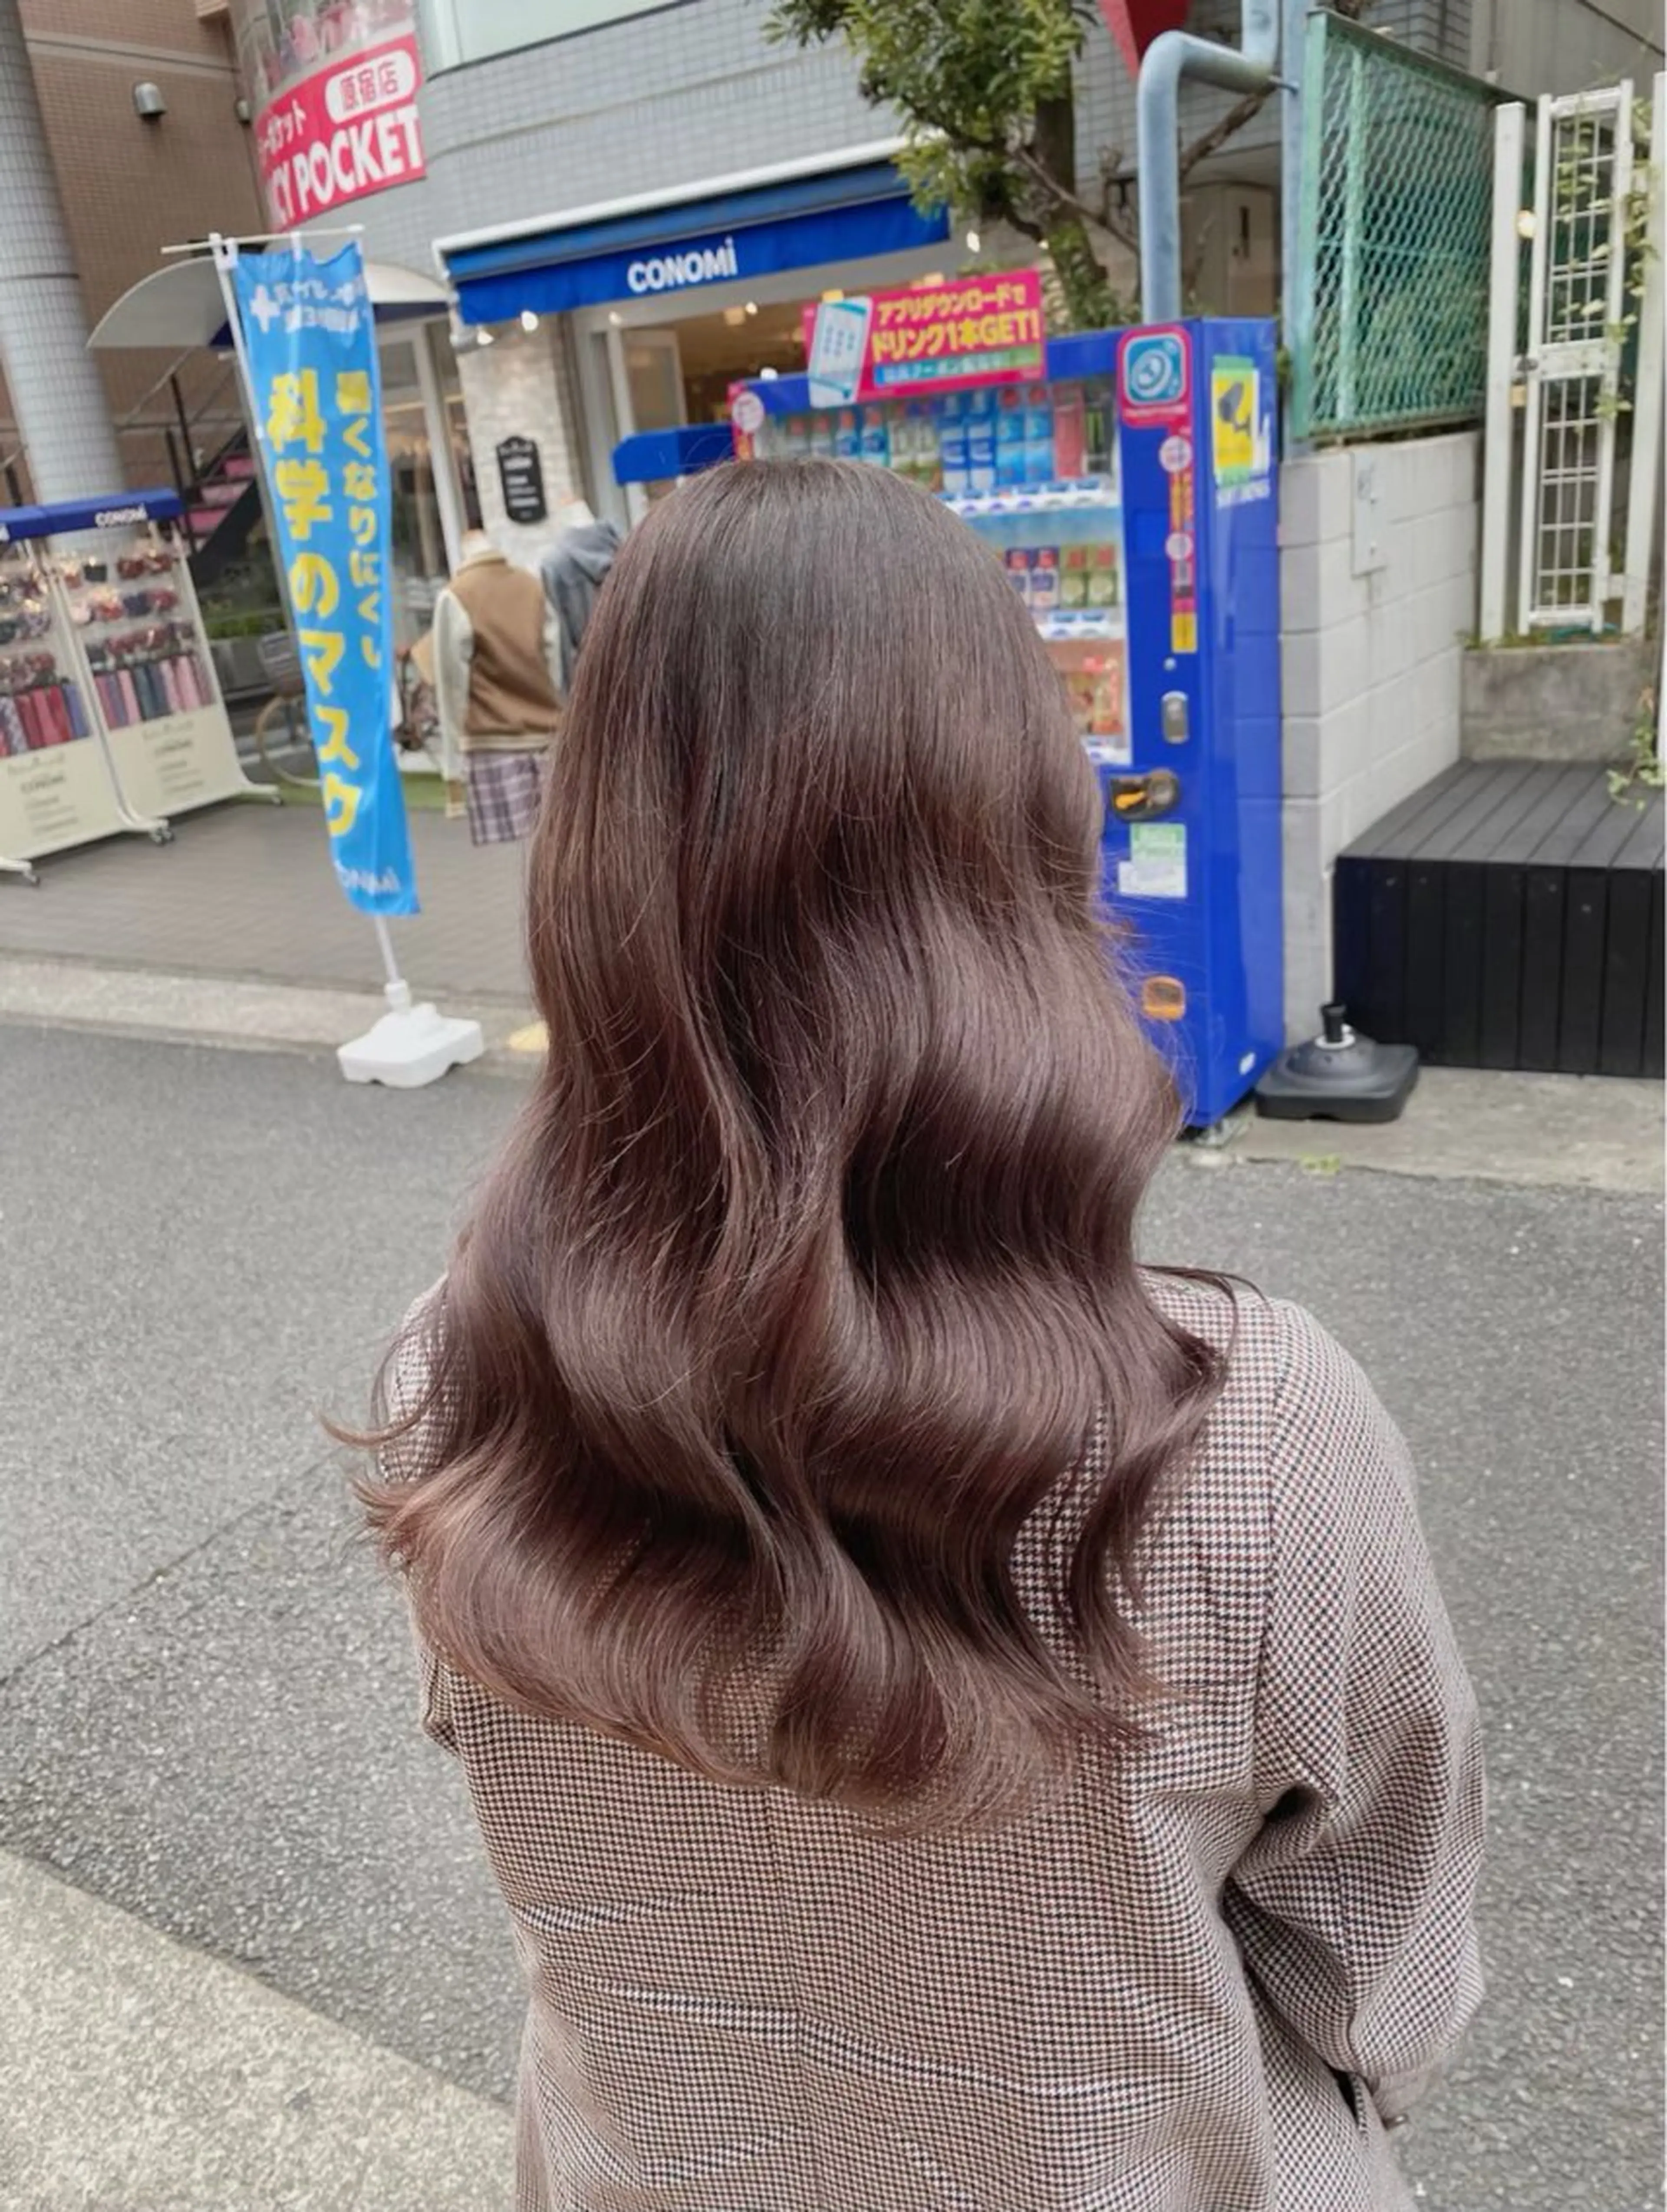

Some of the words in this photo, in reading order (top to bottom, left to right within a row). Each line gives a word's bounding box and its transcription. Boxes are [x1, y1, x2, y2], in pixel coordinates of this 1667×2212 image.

[340, 60, 399, 111] 原宿店
[292, 104, 423, 213] POCKET
[267, 367, 362, 836] 科学のマスク
